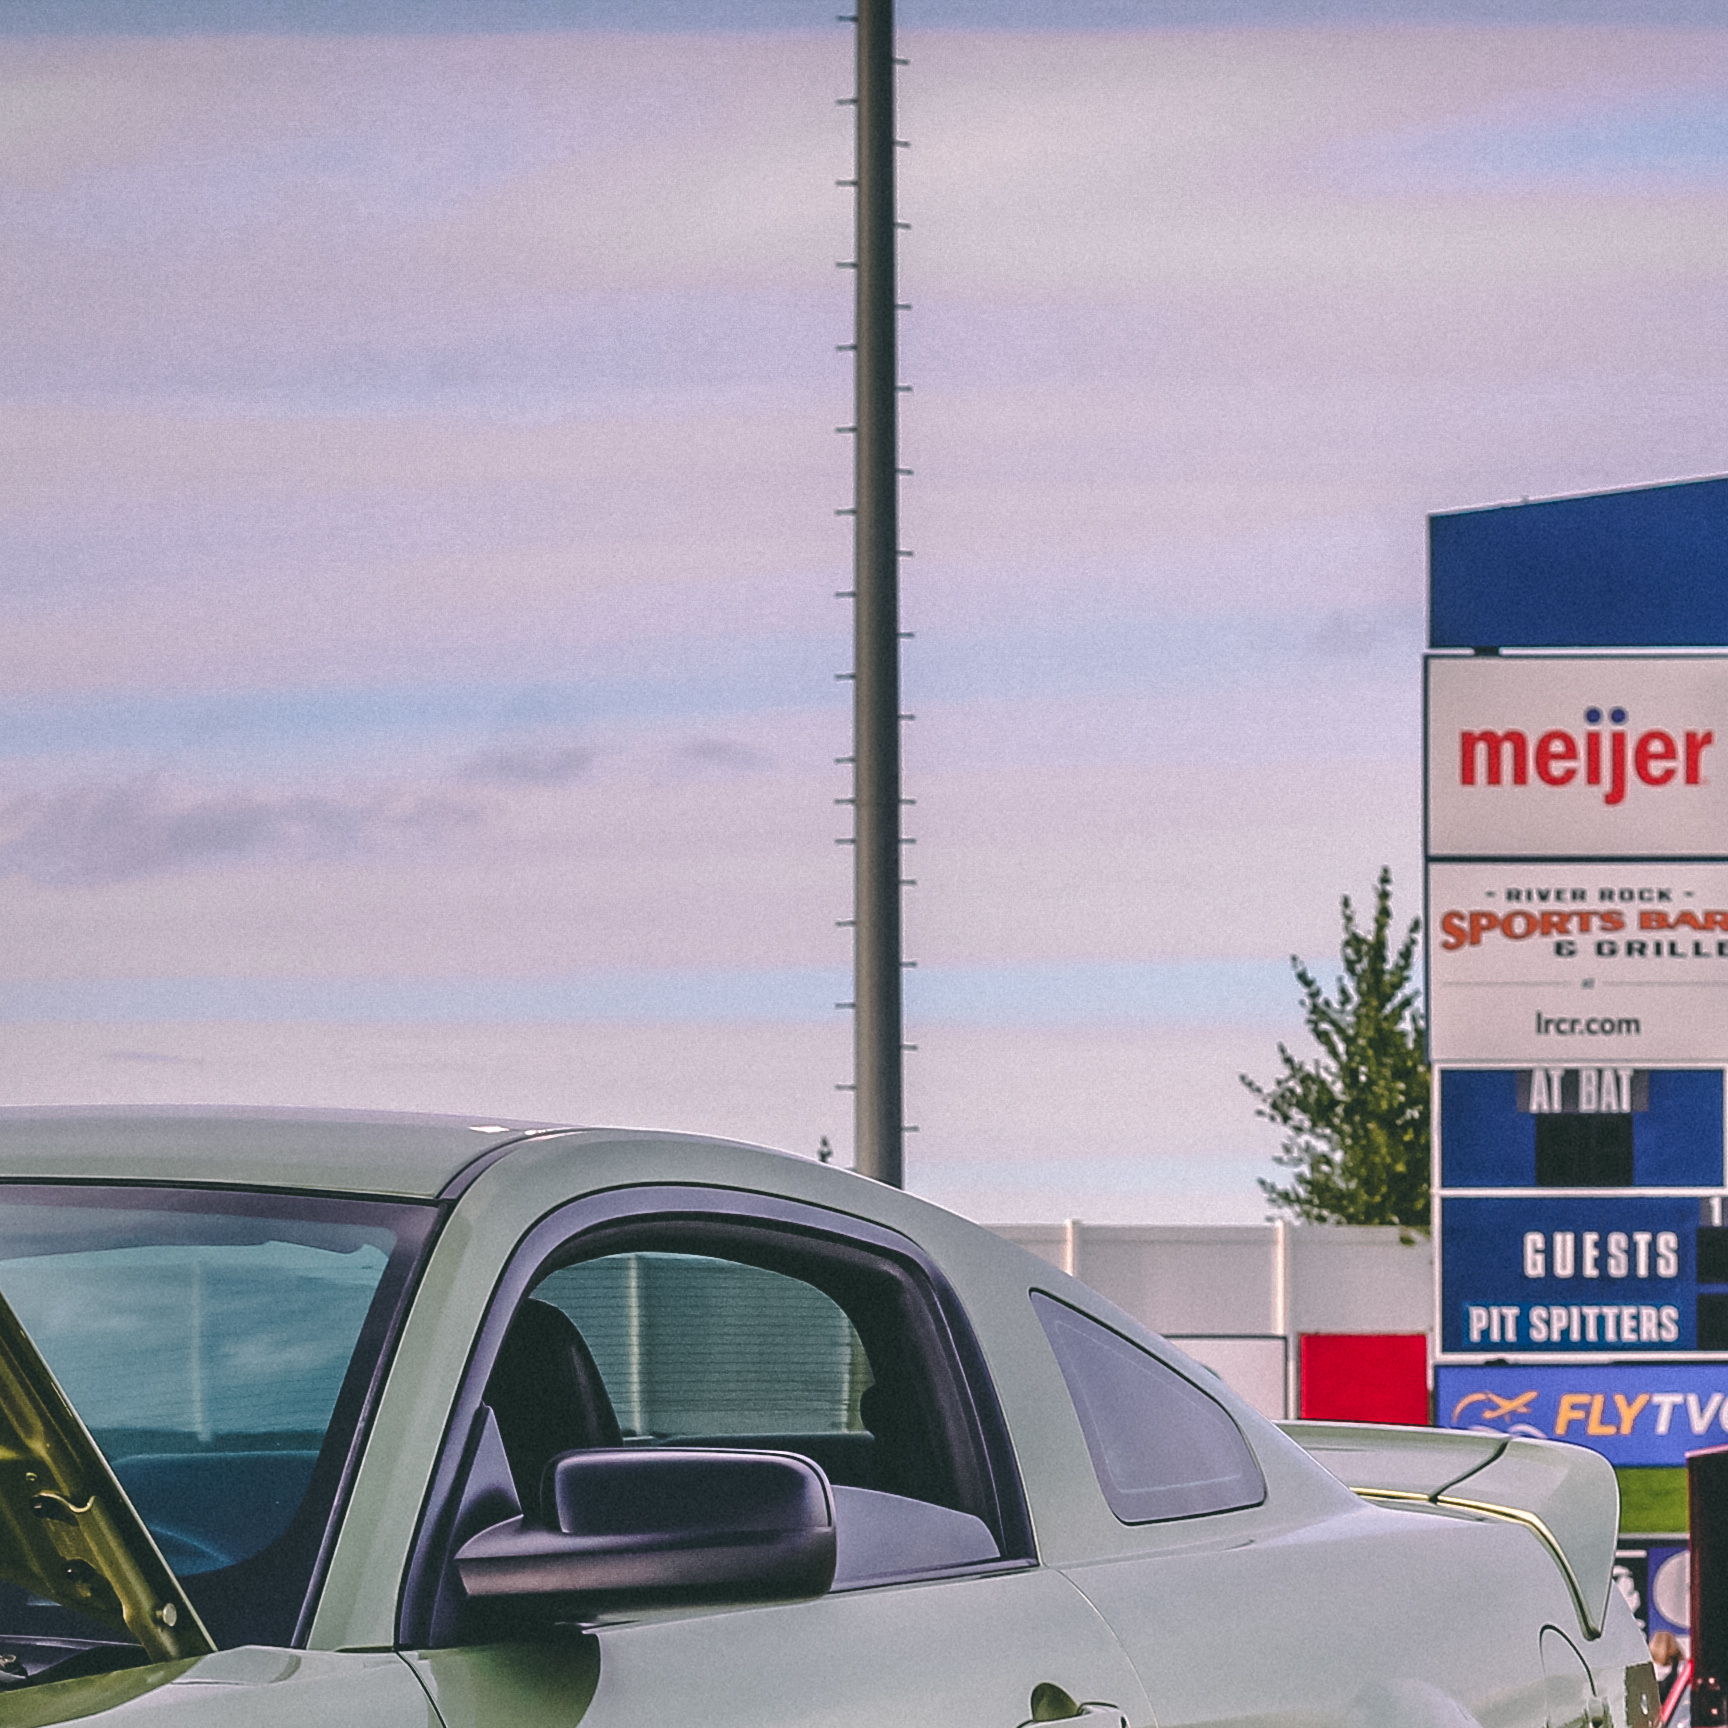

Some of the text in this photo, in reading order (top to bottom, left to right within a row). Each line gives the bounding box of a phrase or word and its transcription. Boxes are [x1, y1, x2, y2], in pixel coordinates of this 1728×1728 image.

[1460, 706, 1715, 806] meijer
[1505, 887, 1674, 903] RIVER ROCK
[1441, 909, 1625, 951] SPORTS
[1535, 1010, 1642, 1035] lrcr.com
[1528, 1066, 1635, 1113] AT BAT
[1709, 1194, 1725, 1227] 1
[1522, 1230, 1679, 1279] GUESTS
[1468, 1305, 1680, 1344] PIT SPITTERS
